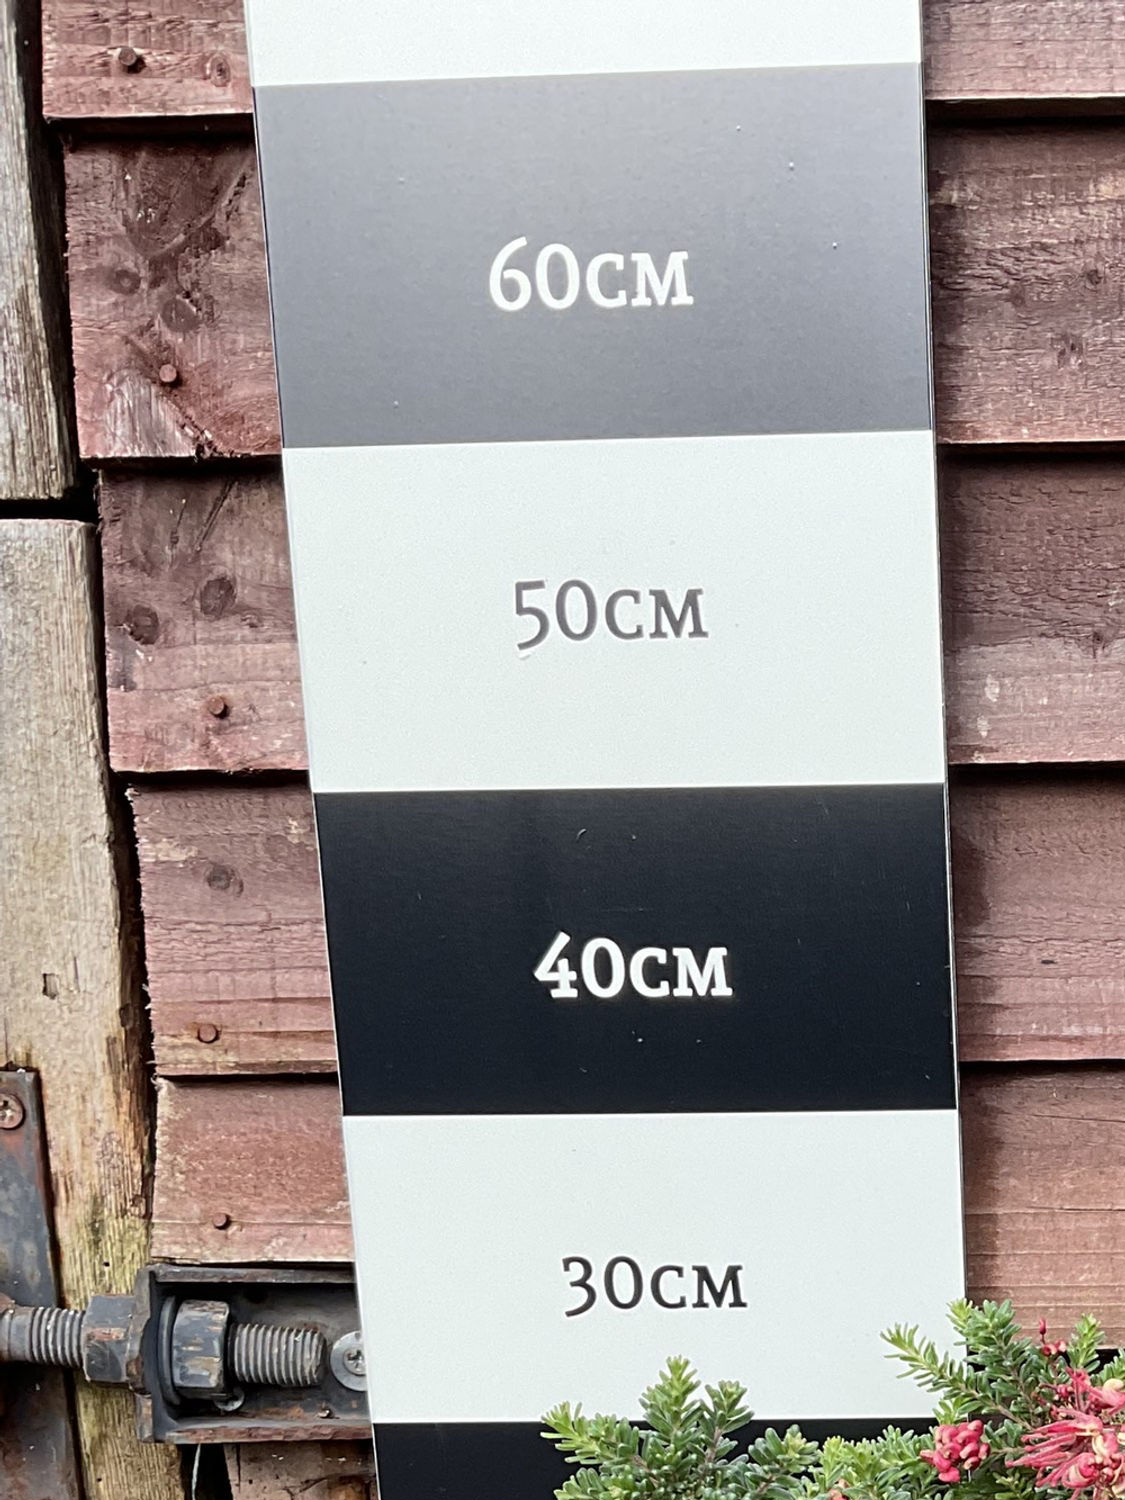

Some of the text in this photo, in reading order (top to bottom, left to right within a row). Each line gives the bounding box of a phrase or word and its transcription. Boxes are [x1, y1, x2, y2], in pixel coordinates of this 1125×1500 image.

[489, 236, 694, 312] 60CM
[515, 579, 709, 651] 50CM
[533, 931, 733, 999] 40CM
[562, 1256, 748, 1318] 30CM
